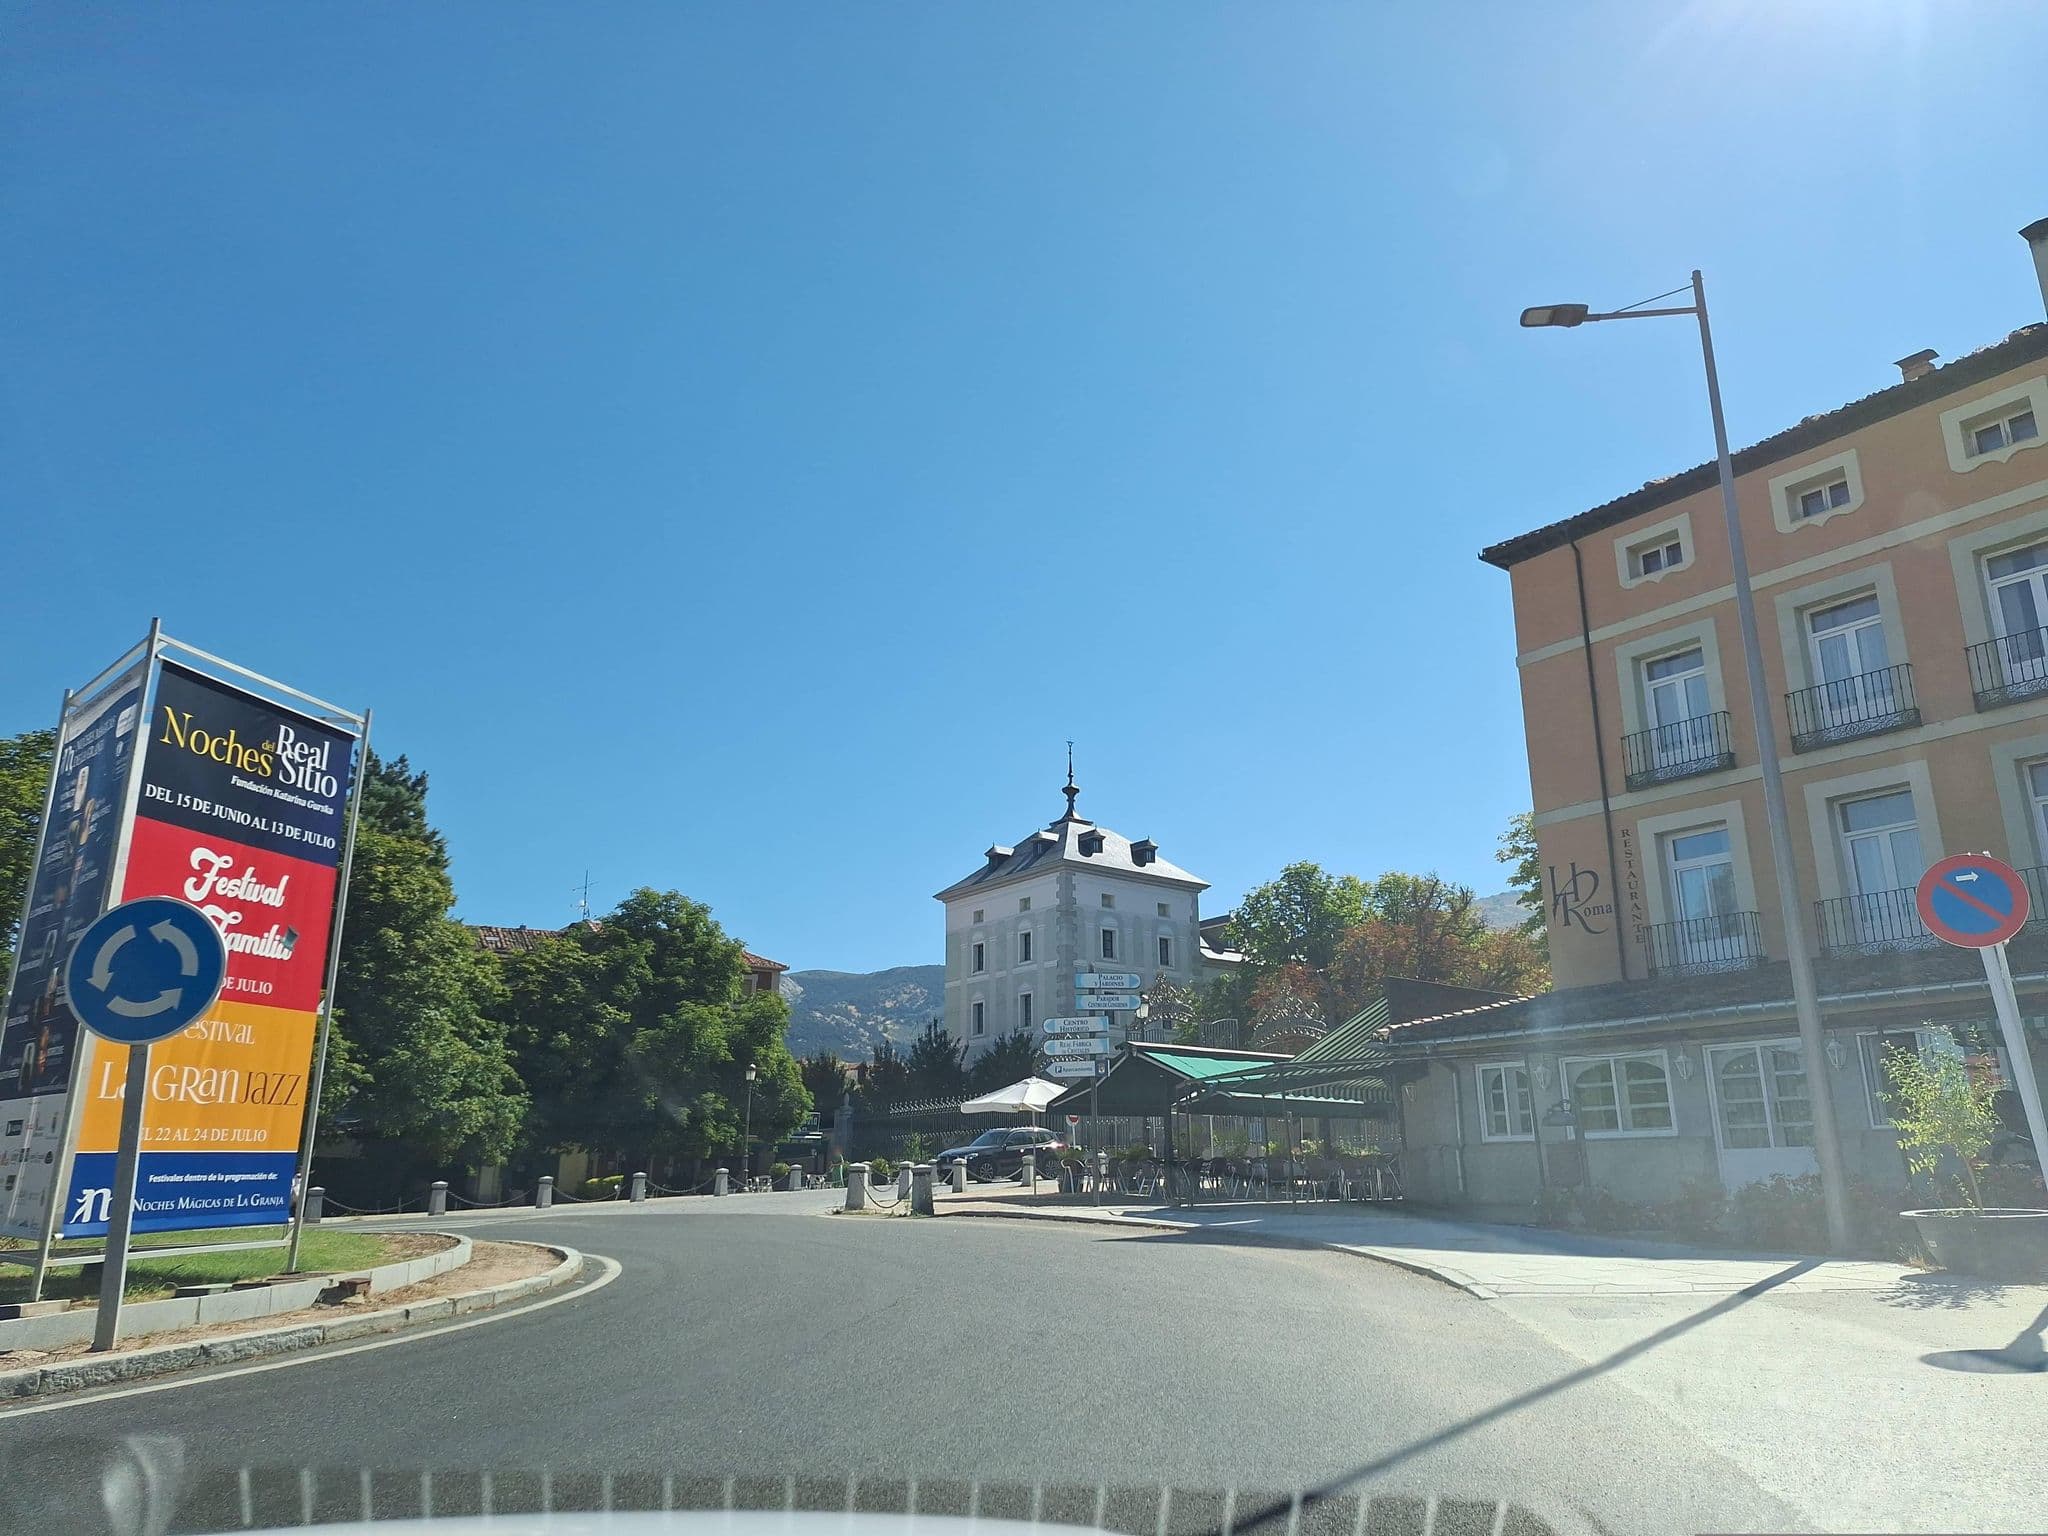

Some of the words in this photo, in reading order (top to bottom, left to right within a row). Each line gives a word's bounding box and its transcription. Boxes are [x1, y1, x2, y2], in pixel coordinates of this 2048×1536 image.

[159, 705, 273, 777] Noches
[261, 739, 276, 752] del
[275, 724, 330, 771] Real
[278, 749, 338, 798] Sitio
[145, 783, 174, 803] DEL
[176, 793, 192, 808] 15
[192, 797, 212, 814] DE
[212, 804, 251, 826] JUNIO
[251, 816, 269, 831] AL
[271, 821, 284, 835] 13
[285, 825, 302, 840] DE
[302, 830, 336, 849] JULIO
[183, 847, 289, 908] Festival
[1620, 828, 1646, 944] RESTAURANTE
[236, 978, 273, 995] JULIO
[155, 1127, 170, 1141] 22
[173, 1128, 191, 1141] AL
[193, 1128, 208, 1141] 24
[211, 1128, 229, 1141] DE
[230, 1128, 267, 1142] JULIO
[133, 1198, 175, 1212] NOCHES
[177, 1196, 221, 1210] MÁGICAS
[223, 1198, 235, 1208] DE
[237, 1194, 248, 1207] LA
[250, 1193, 284, 1206] GRANJA
[149, 1174, 183, 1183] Festivales
[184, 1173, 207, 1182] dentro
[207, 1173, 217, 1181] de
